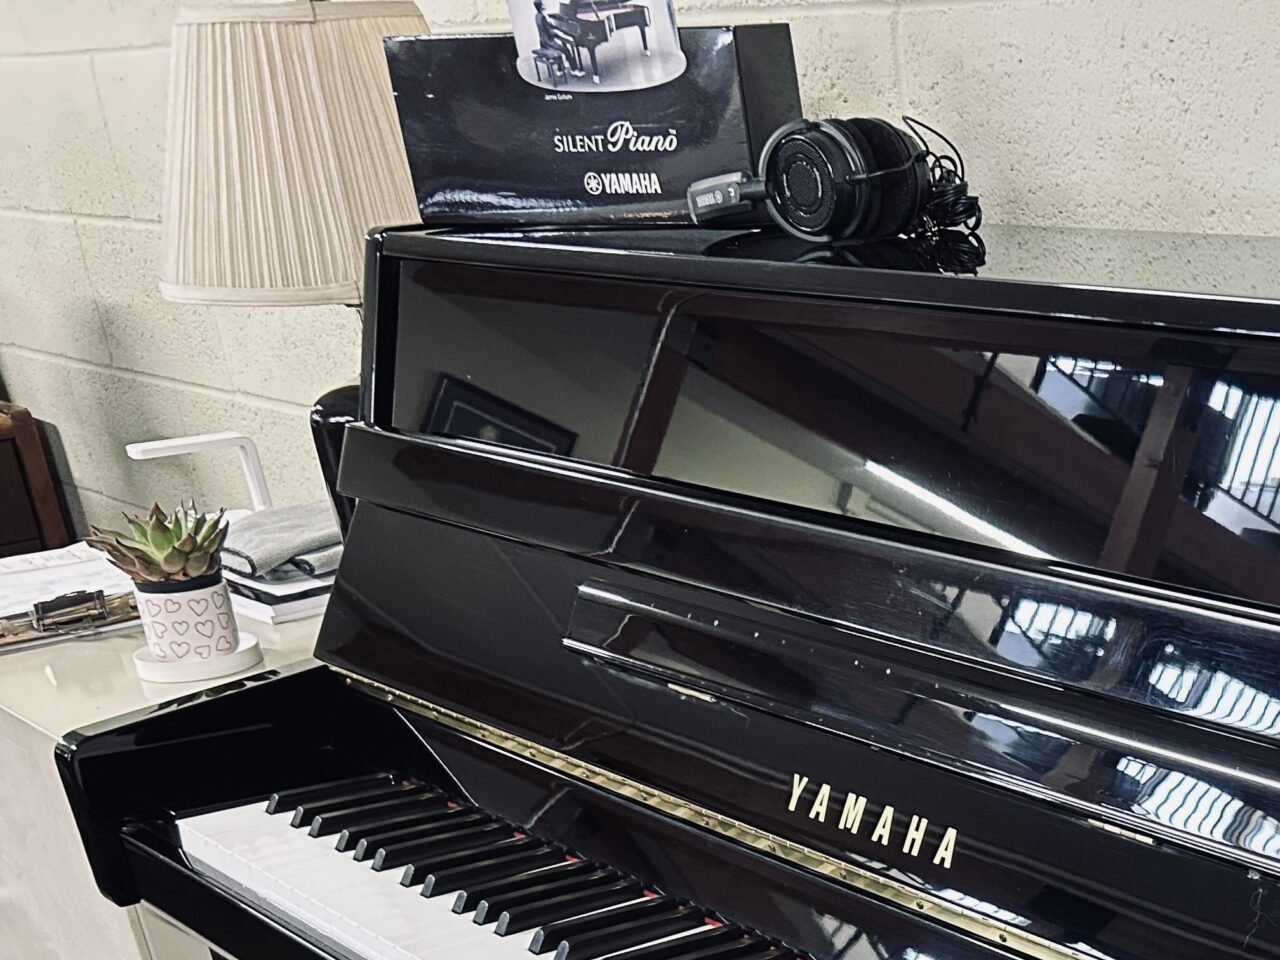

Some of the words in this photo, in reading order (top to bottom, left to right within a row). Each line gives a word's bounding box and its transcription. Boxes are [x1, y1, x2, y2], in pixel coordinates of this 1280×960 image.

[553, 135, 604, 153] SILENT
[606, 120, 678, 153] Piano
[600, 172, 662, 194] YAMAHA
[788, 773, 958, 869] YAMAHA
